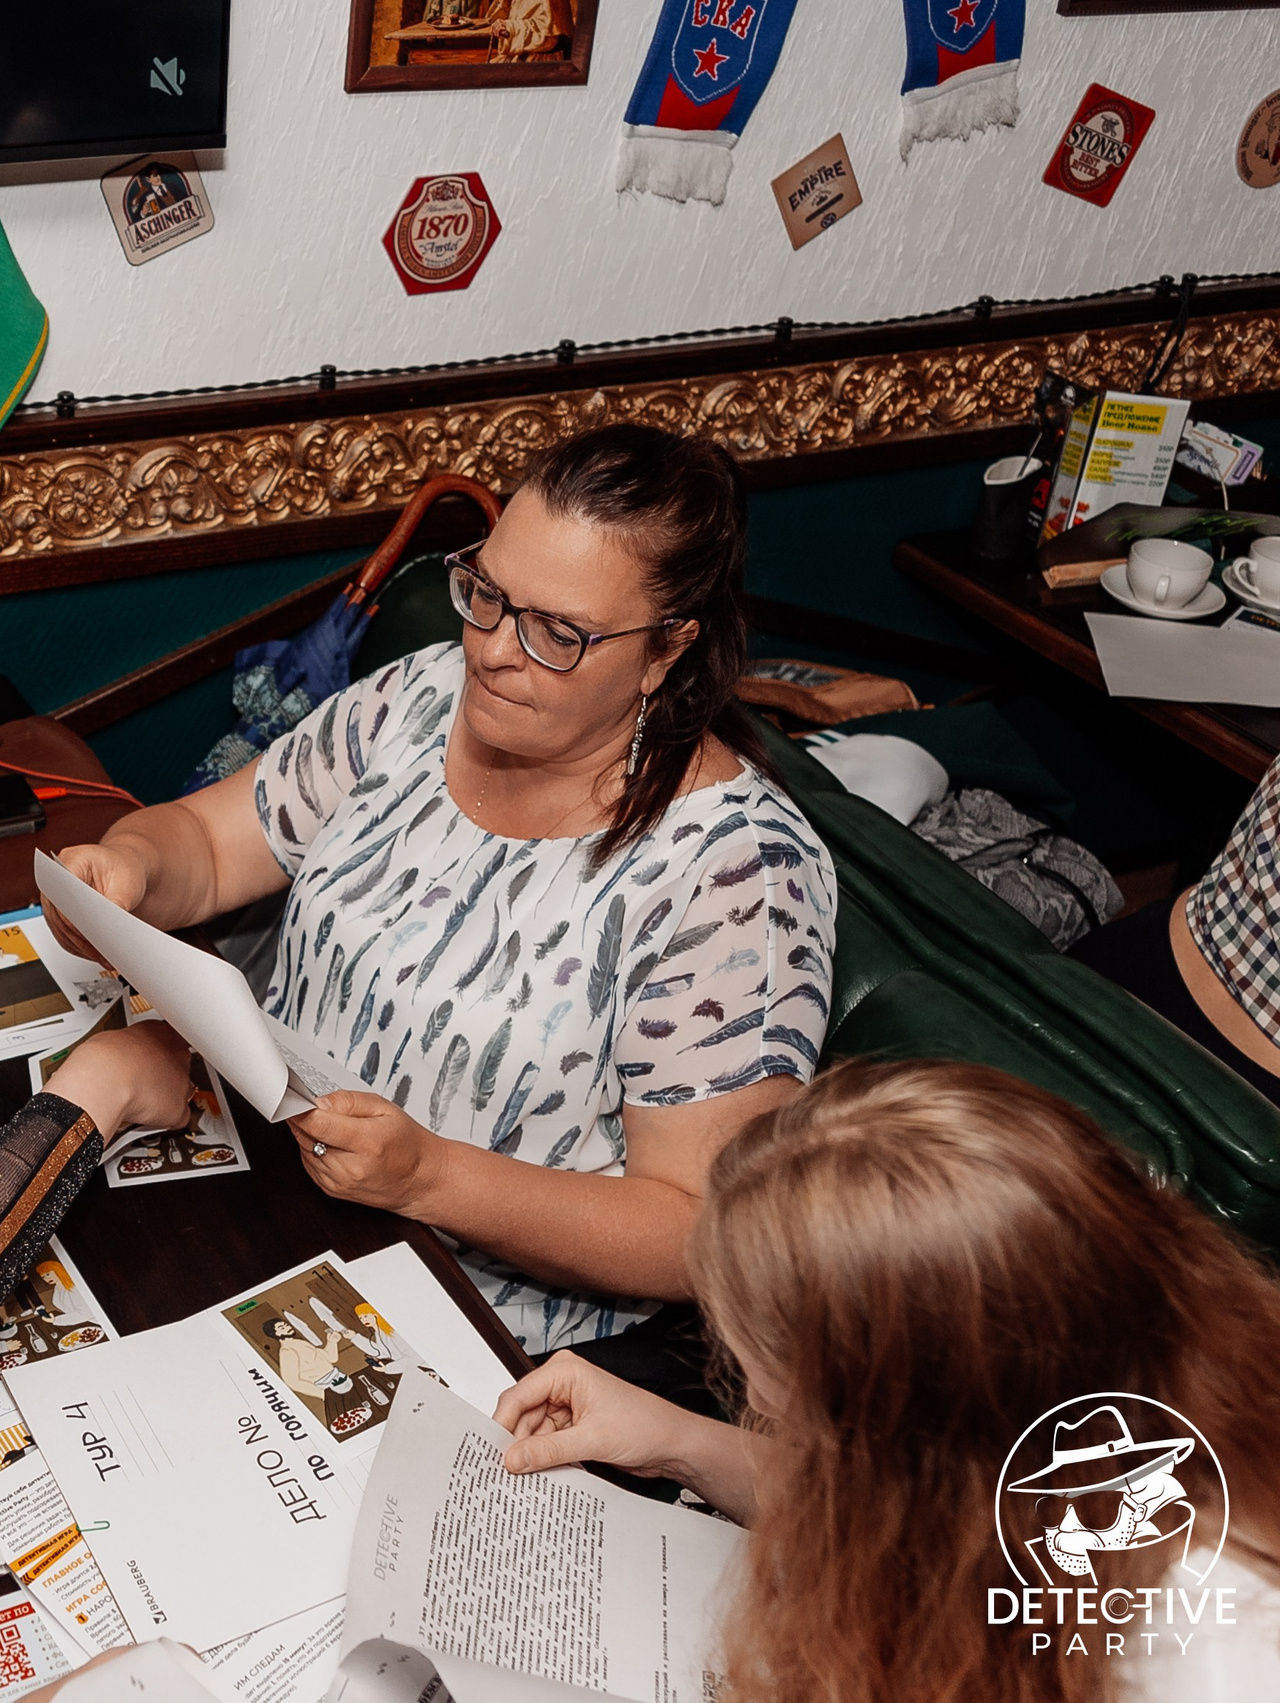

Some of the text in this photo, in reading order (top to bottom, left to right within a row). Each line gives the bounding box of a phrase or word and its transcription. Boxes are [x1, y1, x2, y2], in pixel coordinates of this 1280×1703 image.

[1066, 122, 1131, 166] STONES
[788, 160, 846, 212] EMPIRE
[134, 200, 197, 245] ASCHINGER
[414, 213, 470, 241] 1870
[2, 926, 20, 938] 15
[312, 1265, 334, 1281] 11
[248, 1368, 337, 1483] ПО ГОРЯЧИМ
[80, 1431, 123, 1484] ТУР
[238, 1414, 327, 1526] ДЕЛО №
[12, 1494, 29, 1507] Party
[17, 1528, 72, 1566] ДЕТЕКТИВНАЯ ИГРА
[373, 1492, 399, 1580] DETECTIVE
[388, 1514, 404, 1572] PARTY
[32, 1542, 68, 1575] ДЕТЕКТИВНАЯ
[41, 1556, 84, 1588] ГЛАВНОЕ
[54, 1581, 70, 1594] Игра
[65, 1592, 90, 1612] ИГРА
[127, 1559, 159, 1611] BRAUBERG
[13, 1604, 30, 1617] по
[248, 1642, 285, 1678] СЛЕДАМ
